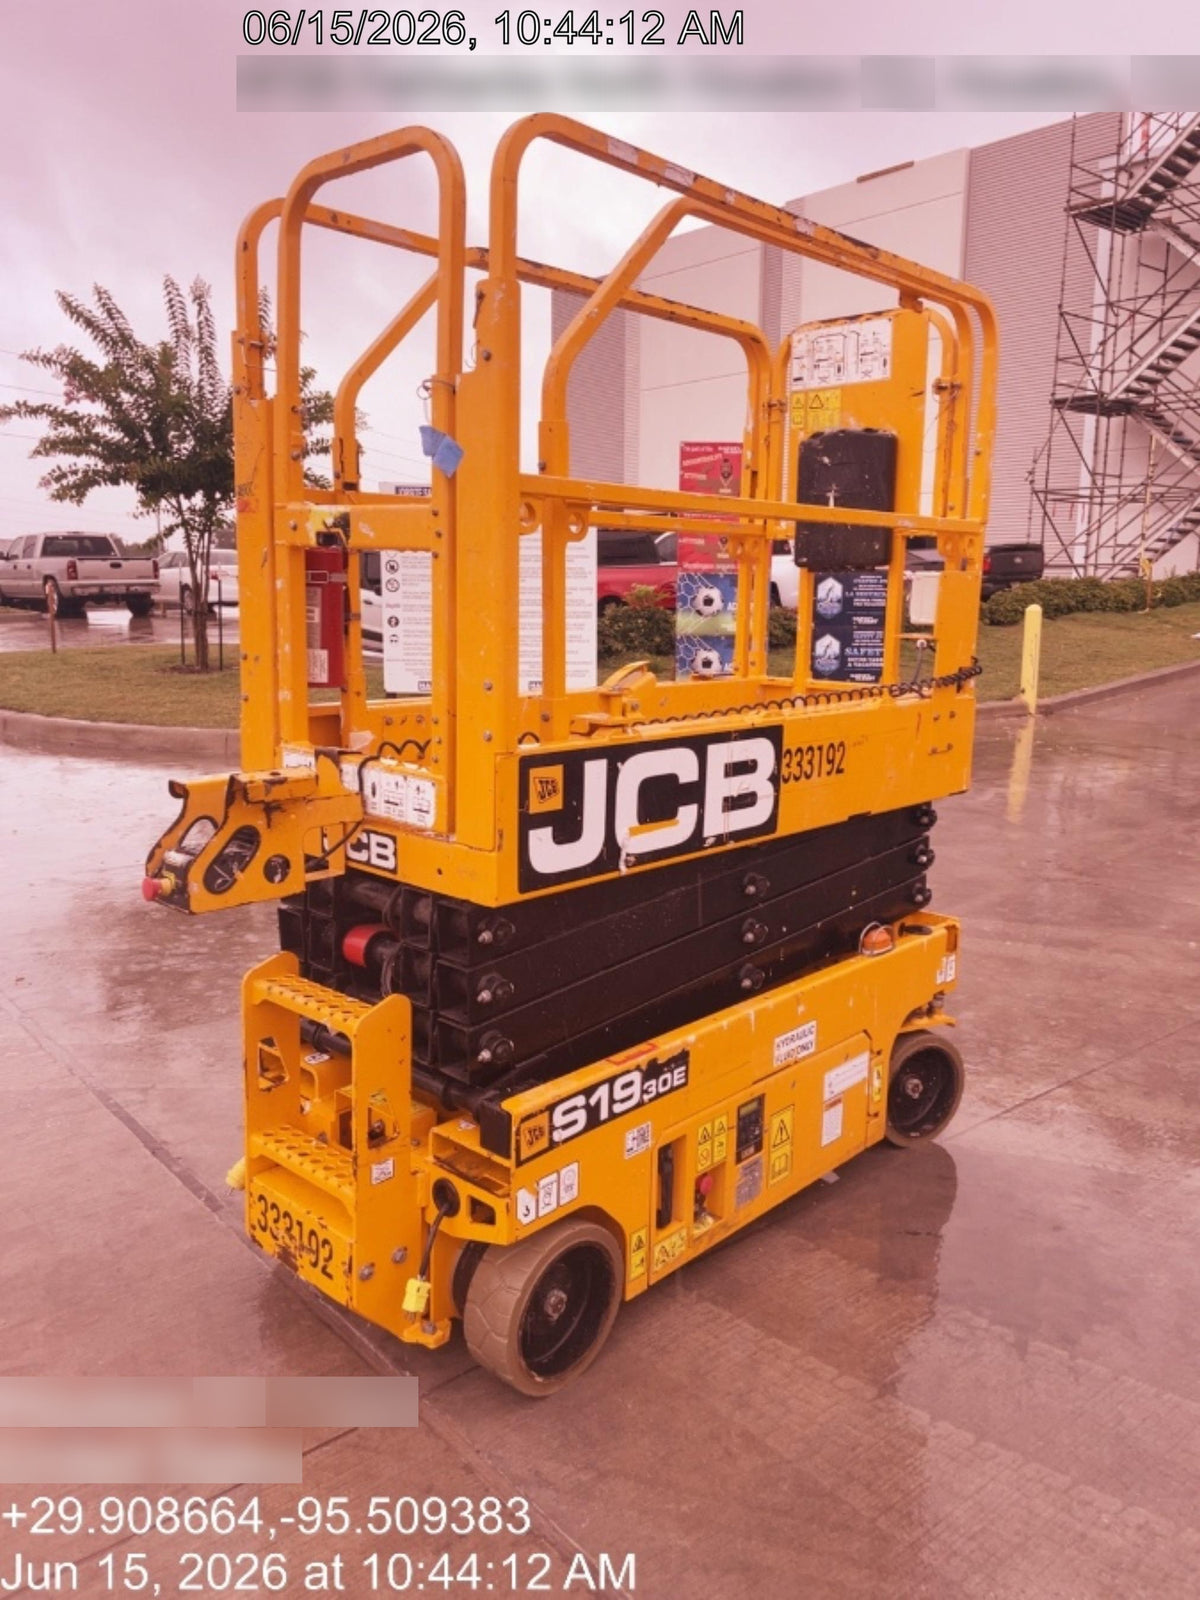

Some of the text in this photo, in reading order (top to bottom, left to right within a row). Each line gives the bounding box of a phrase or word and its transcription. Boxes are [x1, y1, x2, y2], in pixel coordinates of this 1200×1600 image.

[844, 647, 885, 656] SAFET
[781, 740, 846, 784] 333192
[528, 737, 776, 875] JCB
[538, 779, 560, 800] JCB
[324, 827, 396, 870] CB
[552, 1064, 687, 1143] S19 30E
[526, 1126, 545, 1146] JCB
[256, 1193, 334, 1280] 333192
